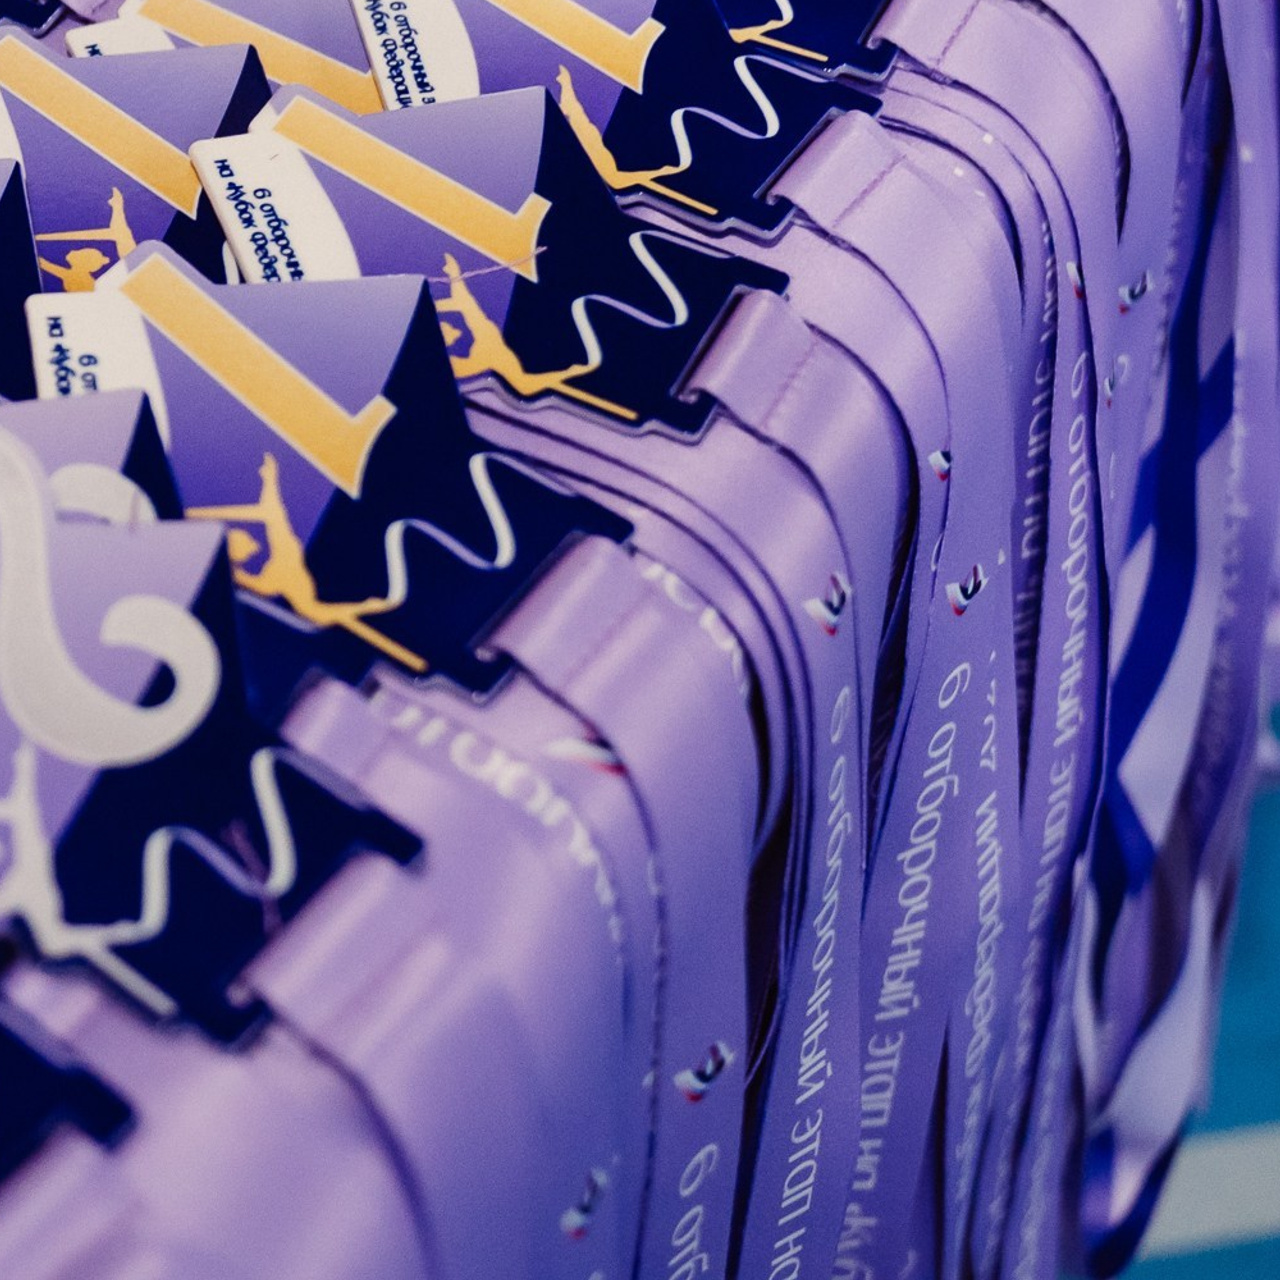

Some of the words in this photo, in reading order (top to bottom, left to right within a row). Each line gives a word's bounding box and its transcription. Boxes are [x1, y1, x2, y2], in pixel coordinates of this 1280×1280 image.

[390, 0, 407, 11] 6
[393, 13, 436, 94] отборочный
[213, 158, 231, 179] на
[224, 181, 256, 229] «Кубок
[252, 187, 272, 200] 6
[47, 316, 65, 338] на
[78, 354, 98, 367] 6
[937, 661, 973, 710] 6
[874, 721, 961, 1021] отборочный
[793, 754, 854, 1106] отборочный
[859, 1030, 906, 1128] этап
[678, 1142, 719, 1198] 6
[776, 1107, 825, 1227] этап
